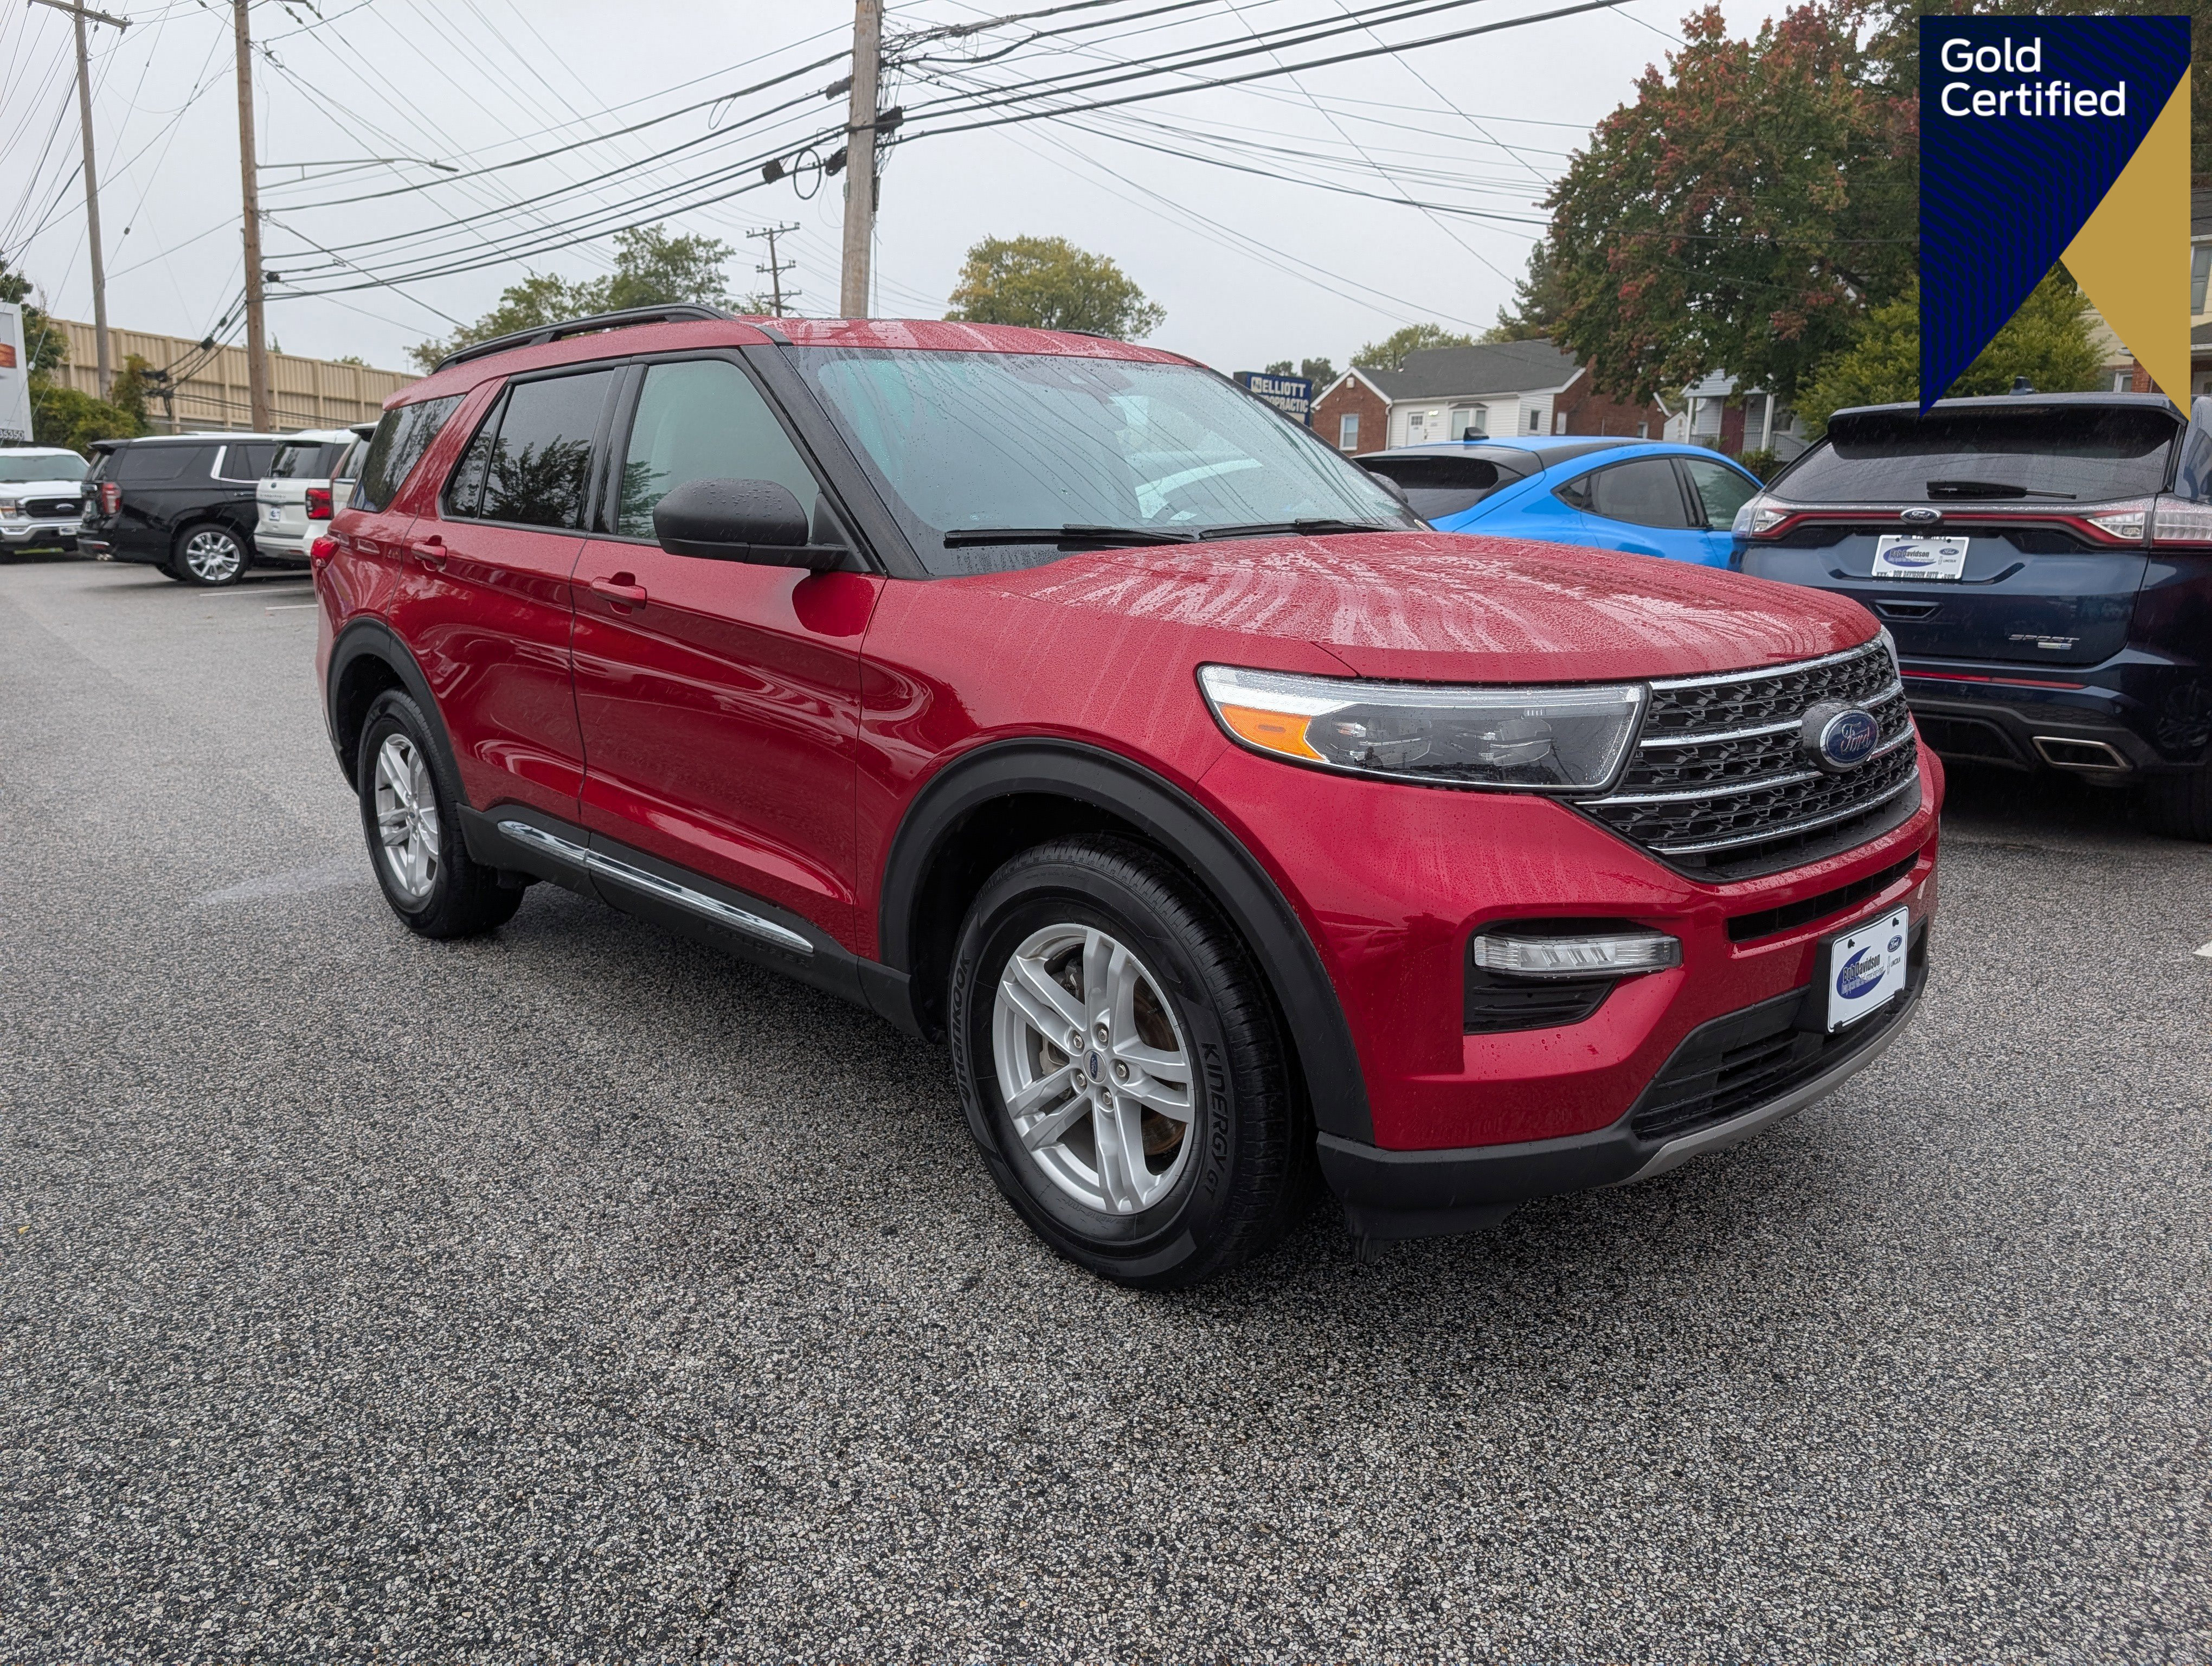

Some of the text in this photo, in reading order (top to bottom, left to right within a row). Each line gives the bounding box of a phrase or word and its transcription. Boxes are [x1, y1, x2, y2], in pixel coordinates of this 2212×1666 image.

[1263, 379, 1306, 397] ELLIOTT
[1261, 394, 1309, 413] OPRACTIC
[1909, 510, 1930, 520] Ford
[1902, 549, 1930, 558] Davidson
[2009, 634, 2080, 643] SPORT
[1840, 721, 1872, 754] Ford
[1843, 964, 1855, 982] Bob
[1855, 953, 1880, 976] Davidson
